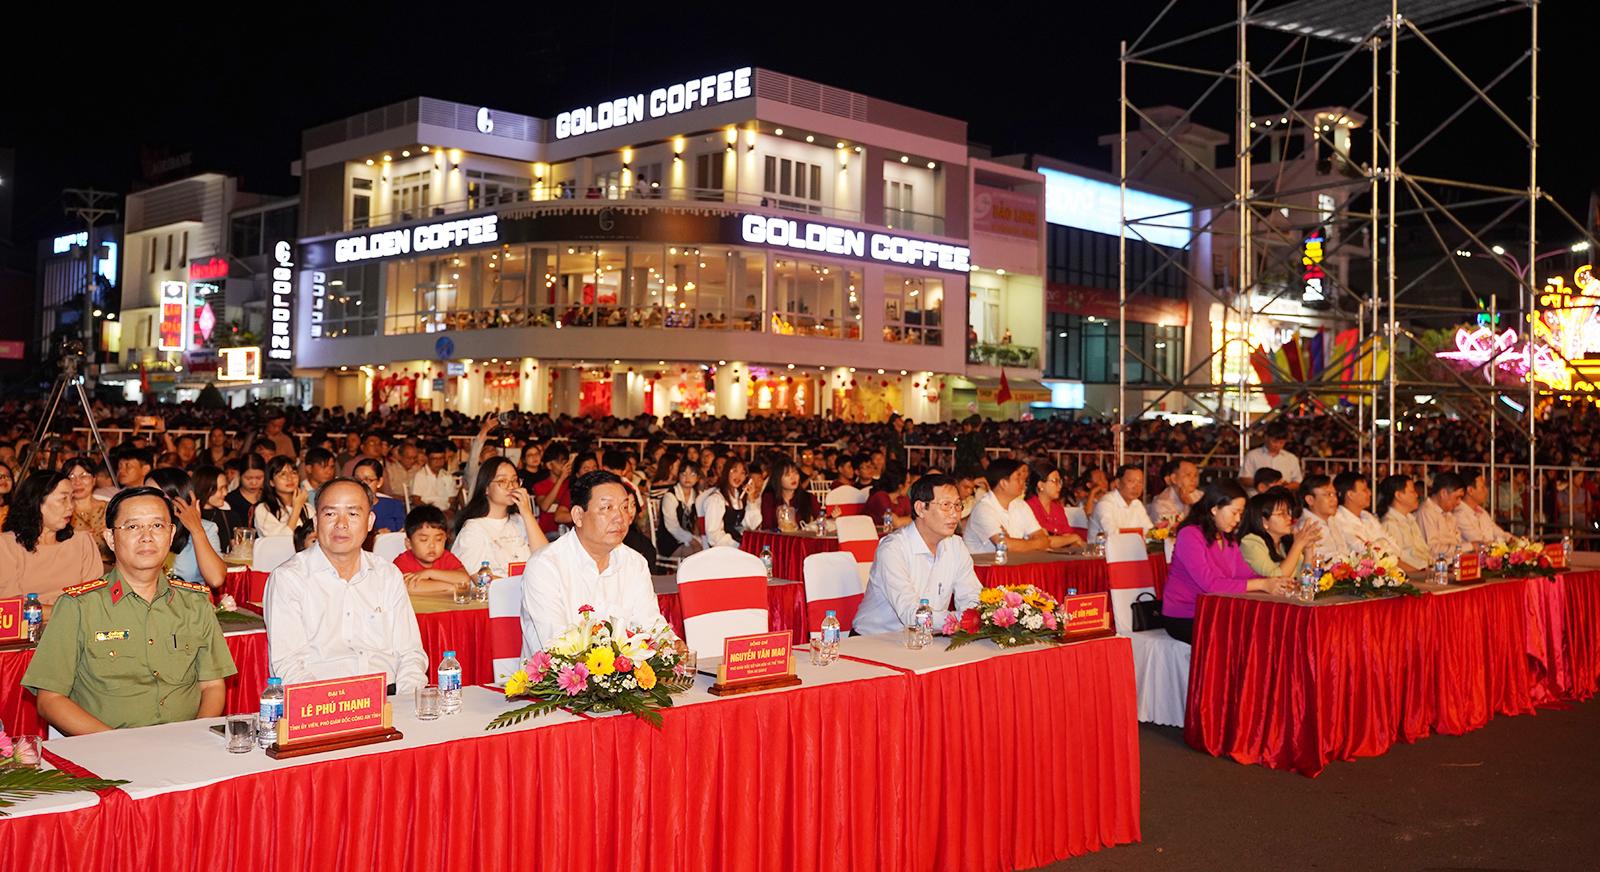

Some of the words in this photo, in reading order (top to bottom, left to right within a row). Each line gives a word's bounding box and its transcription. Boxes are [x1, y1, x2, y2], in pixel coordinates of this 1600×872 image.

[556, 93, 645, 140] GOLDEN
[649, 66, 752, 118] COFFEE
[335, 228, 411, 263] GOLDEN
[413, 214, 499, 252] COFFEE
[742, 214, 866, 257] GOLDEN
[870, 233, 971, 272] COFFEE
[730, 648, 756, 663] NGUYỄN
[757, 647, 770, 659] VĂN
[771, 647, 786, 658] MAO
[301, 703, 313, 718] LÊ
[315, 701, 337, 716] PHÚ
[338, 697, 371, 713] THẠNH
[328, 690, 338, 698] ĐẠI
